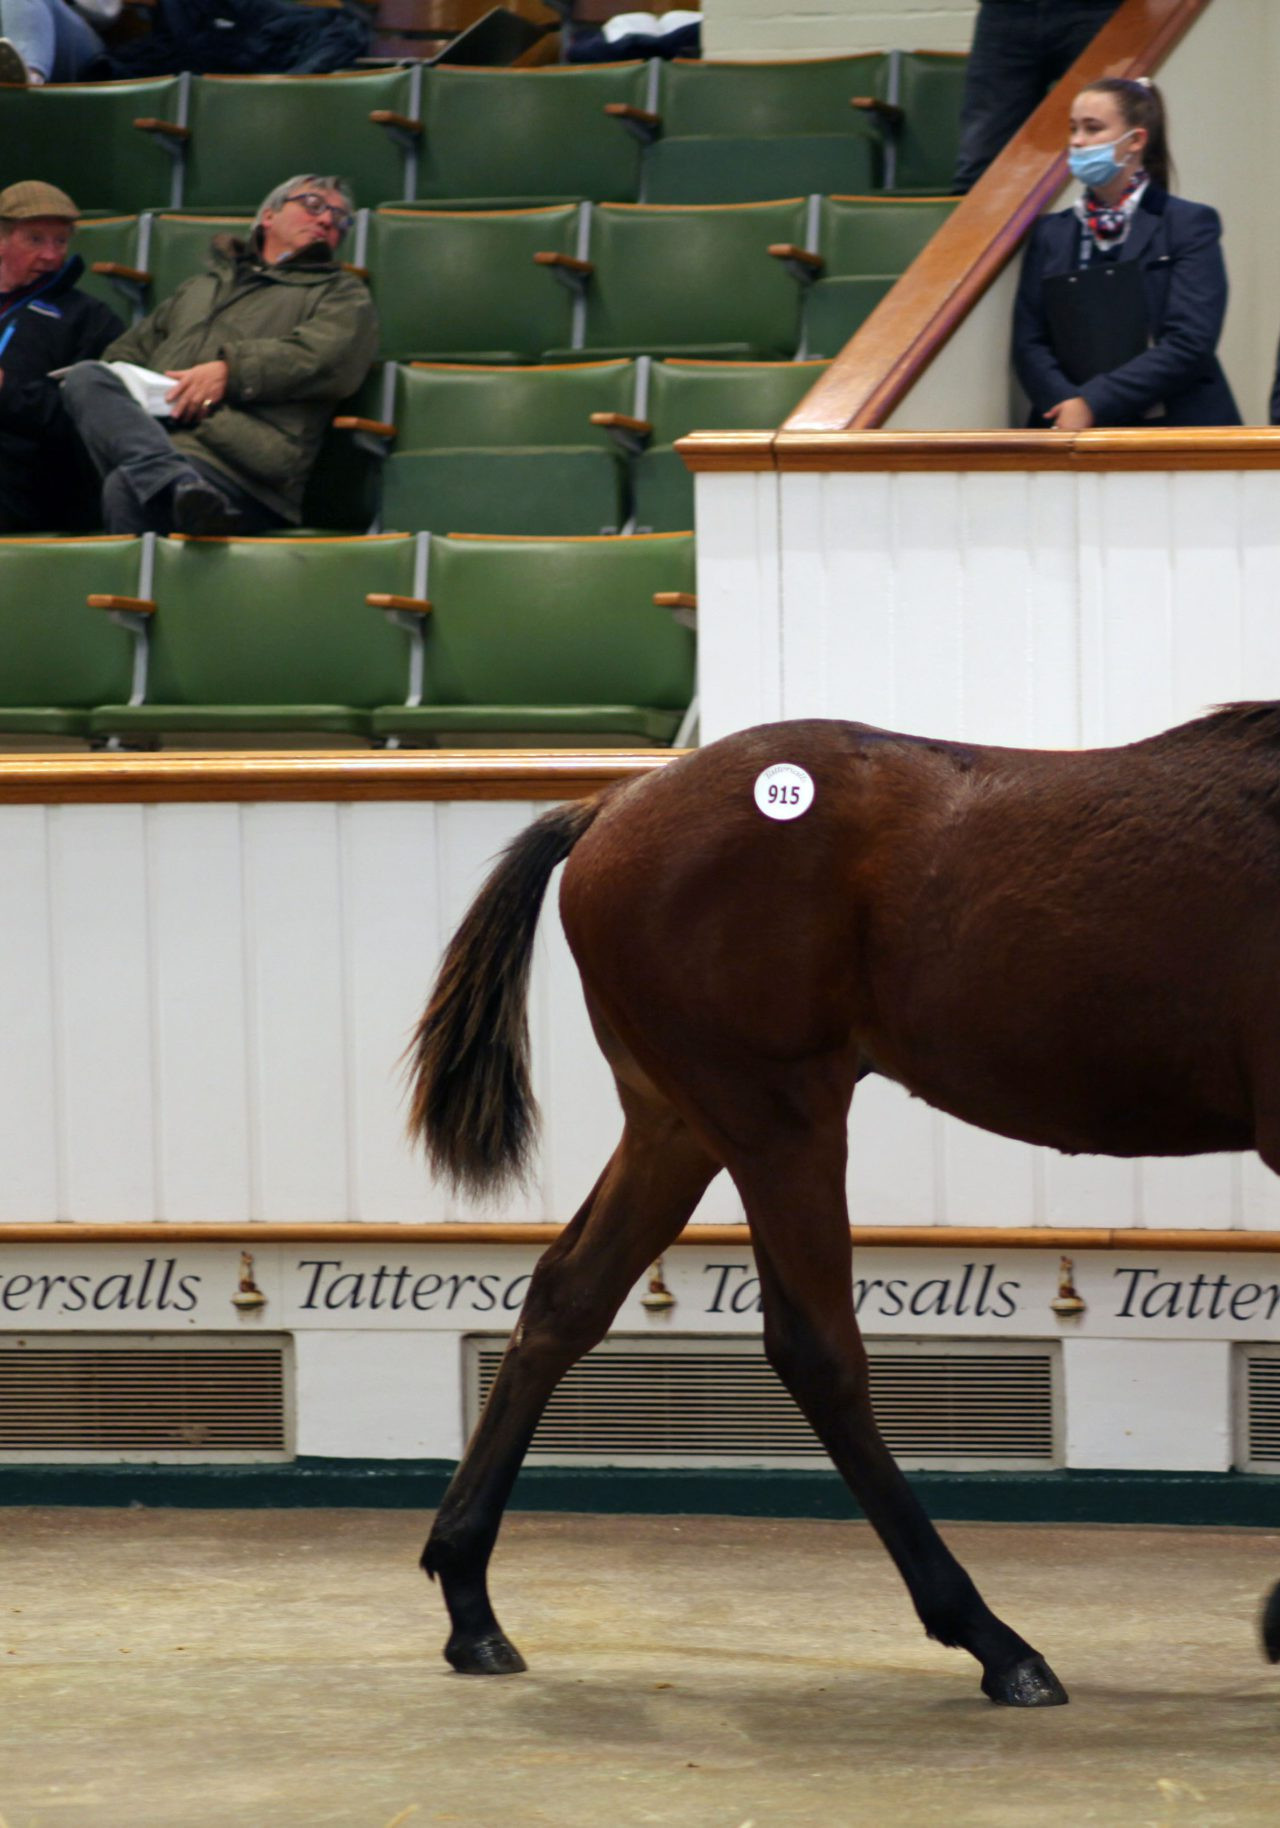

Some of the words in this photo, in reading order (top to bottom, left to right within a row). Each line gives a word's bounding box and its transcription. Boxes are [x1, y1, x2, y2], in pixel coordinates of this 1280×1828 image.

[767, 784, 800, 805] 915
[0, 1257, 201, 1311] ersalls
[703, 1262, 1021, 1318] Tarsalls
